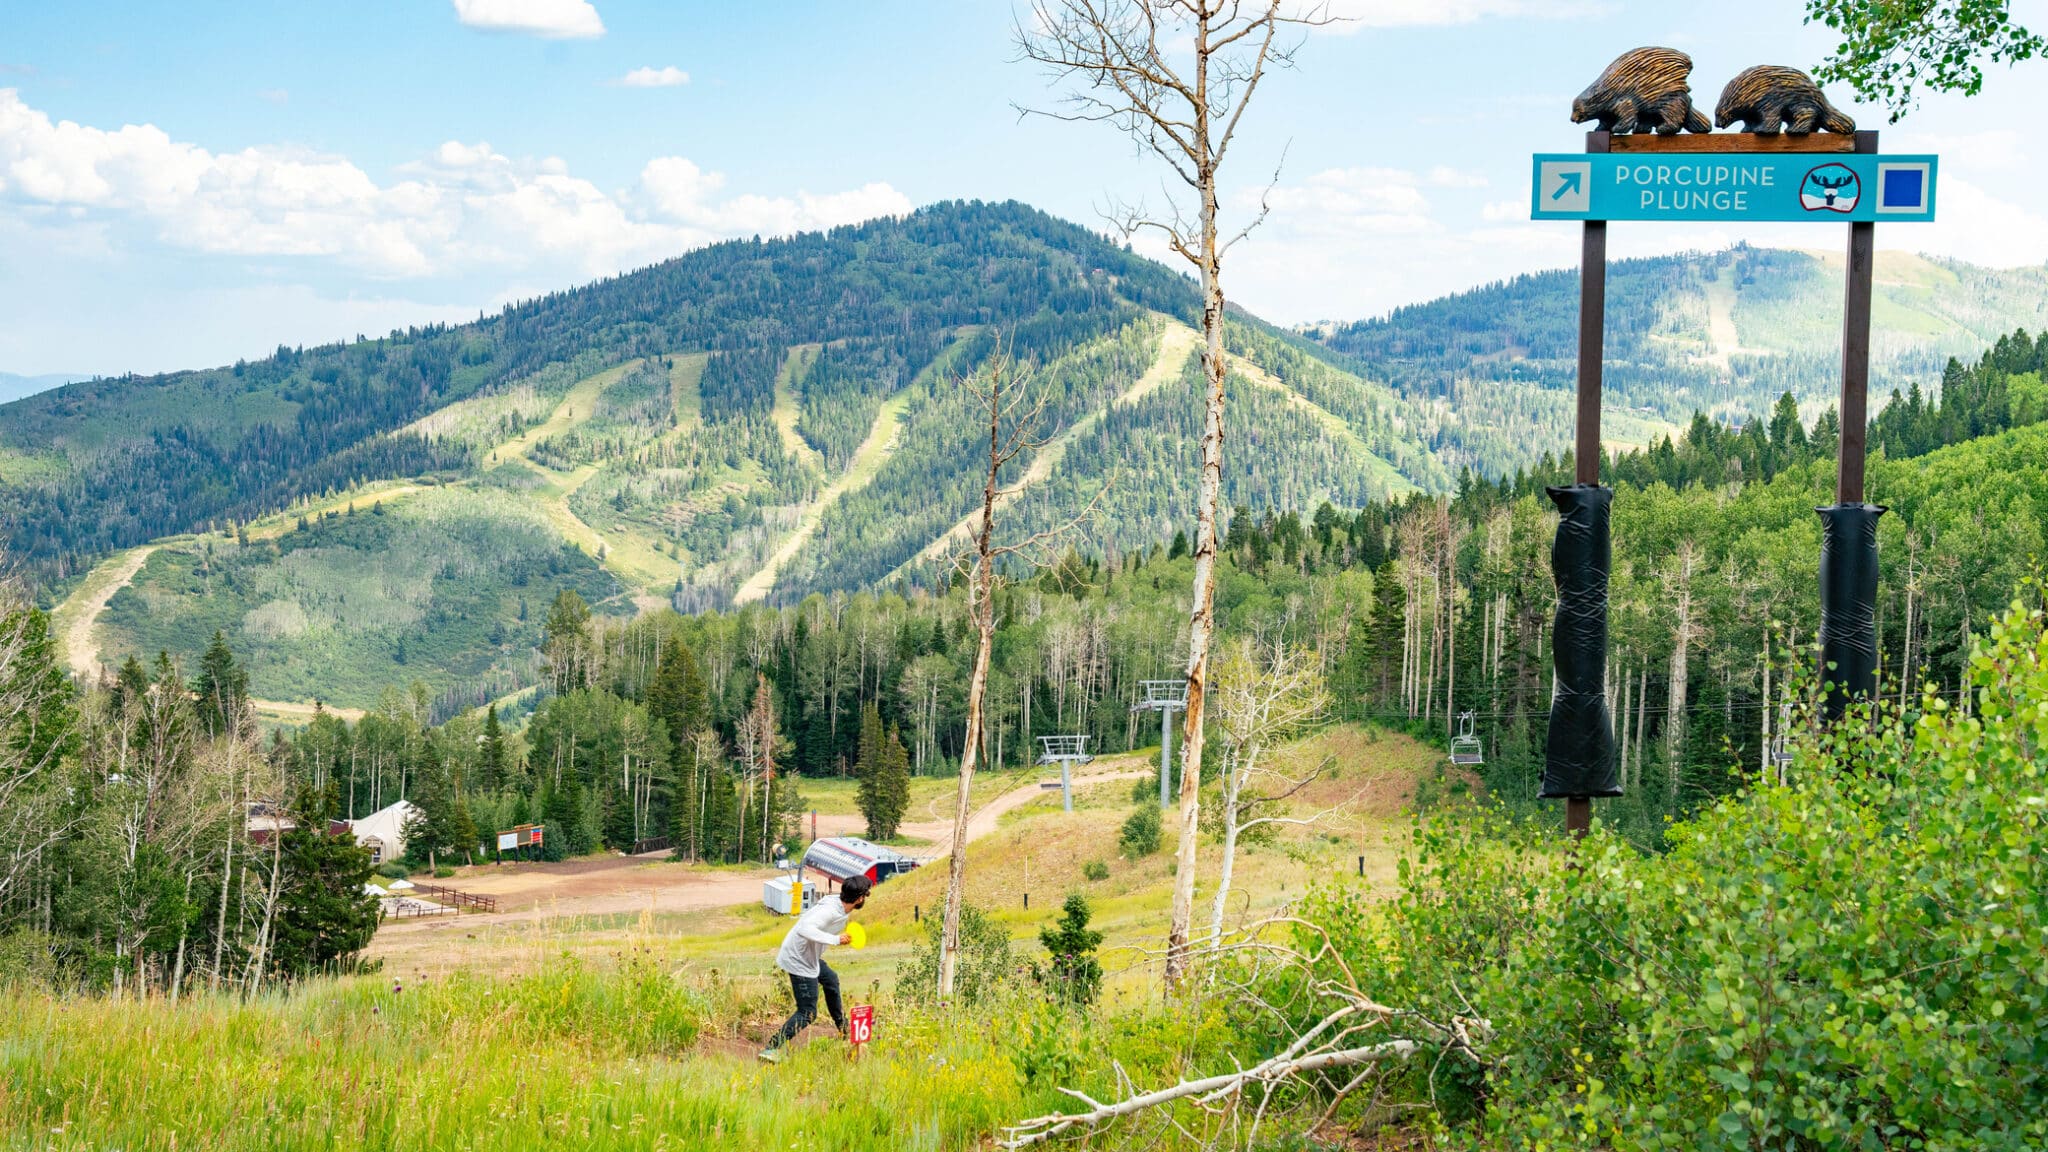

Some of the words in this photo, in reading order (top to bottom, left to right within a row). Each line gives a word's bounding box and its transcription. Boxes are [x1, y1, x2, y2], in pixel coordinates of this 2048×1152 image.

[1616, 165, 1775, 186] PORCUPINE
[1640, 190, 1748, 210] PLUNGE
[853, 1018, 869, 1041] 16
